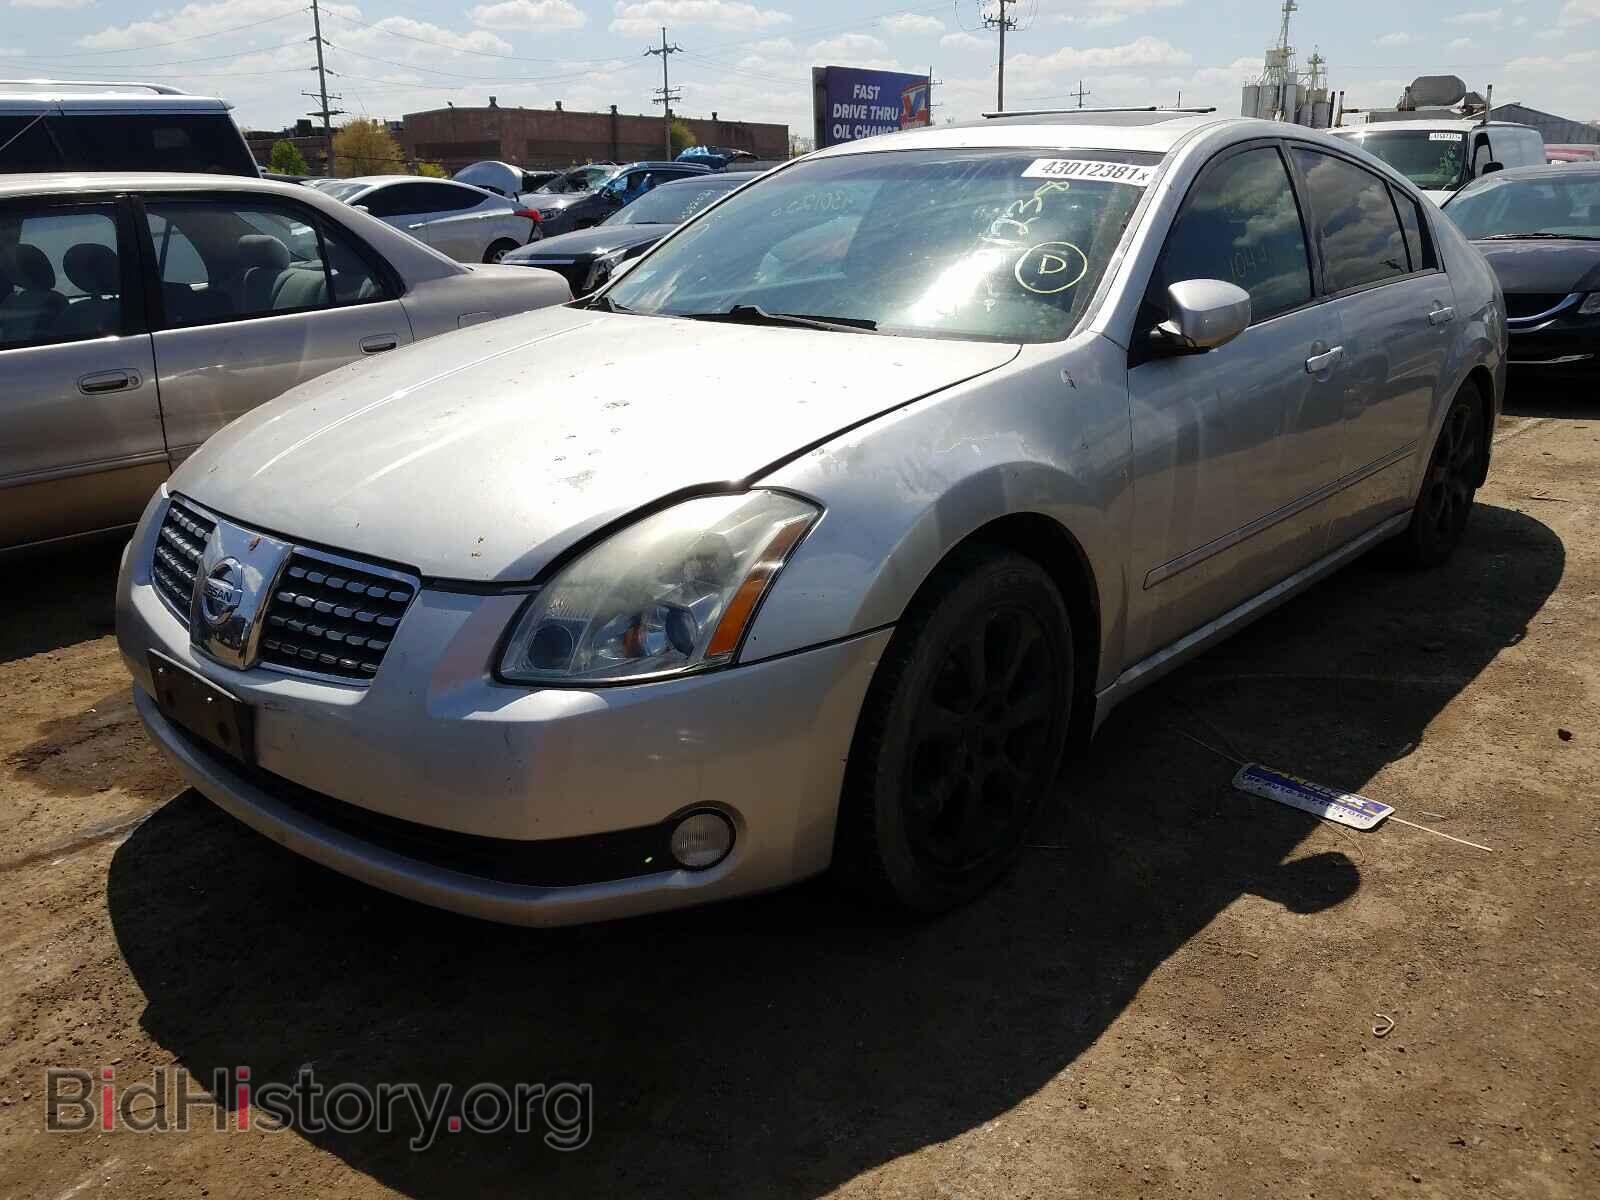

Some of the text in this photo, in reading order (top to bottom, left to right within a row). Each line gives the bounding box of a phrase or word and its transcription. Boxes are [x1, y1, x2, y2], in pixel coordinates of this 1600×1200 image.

[853, 84, 881, 100] FAST
[833, 103, 899, 121] DRIVE THRU
[832, 123, 852, 139] OIL
[1039, 254, 1067, 275] D
